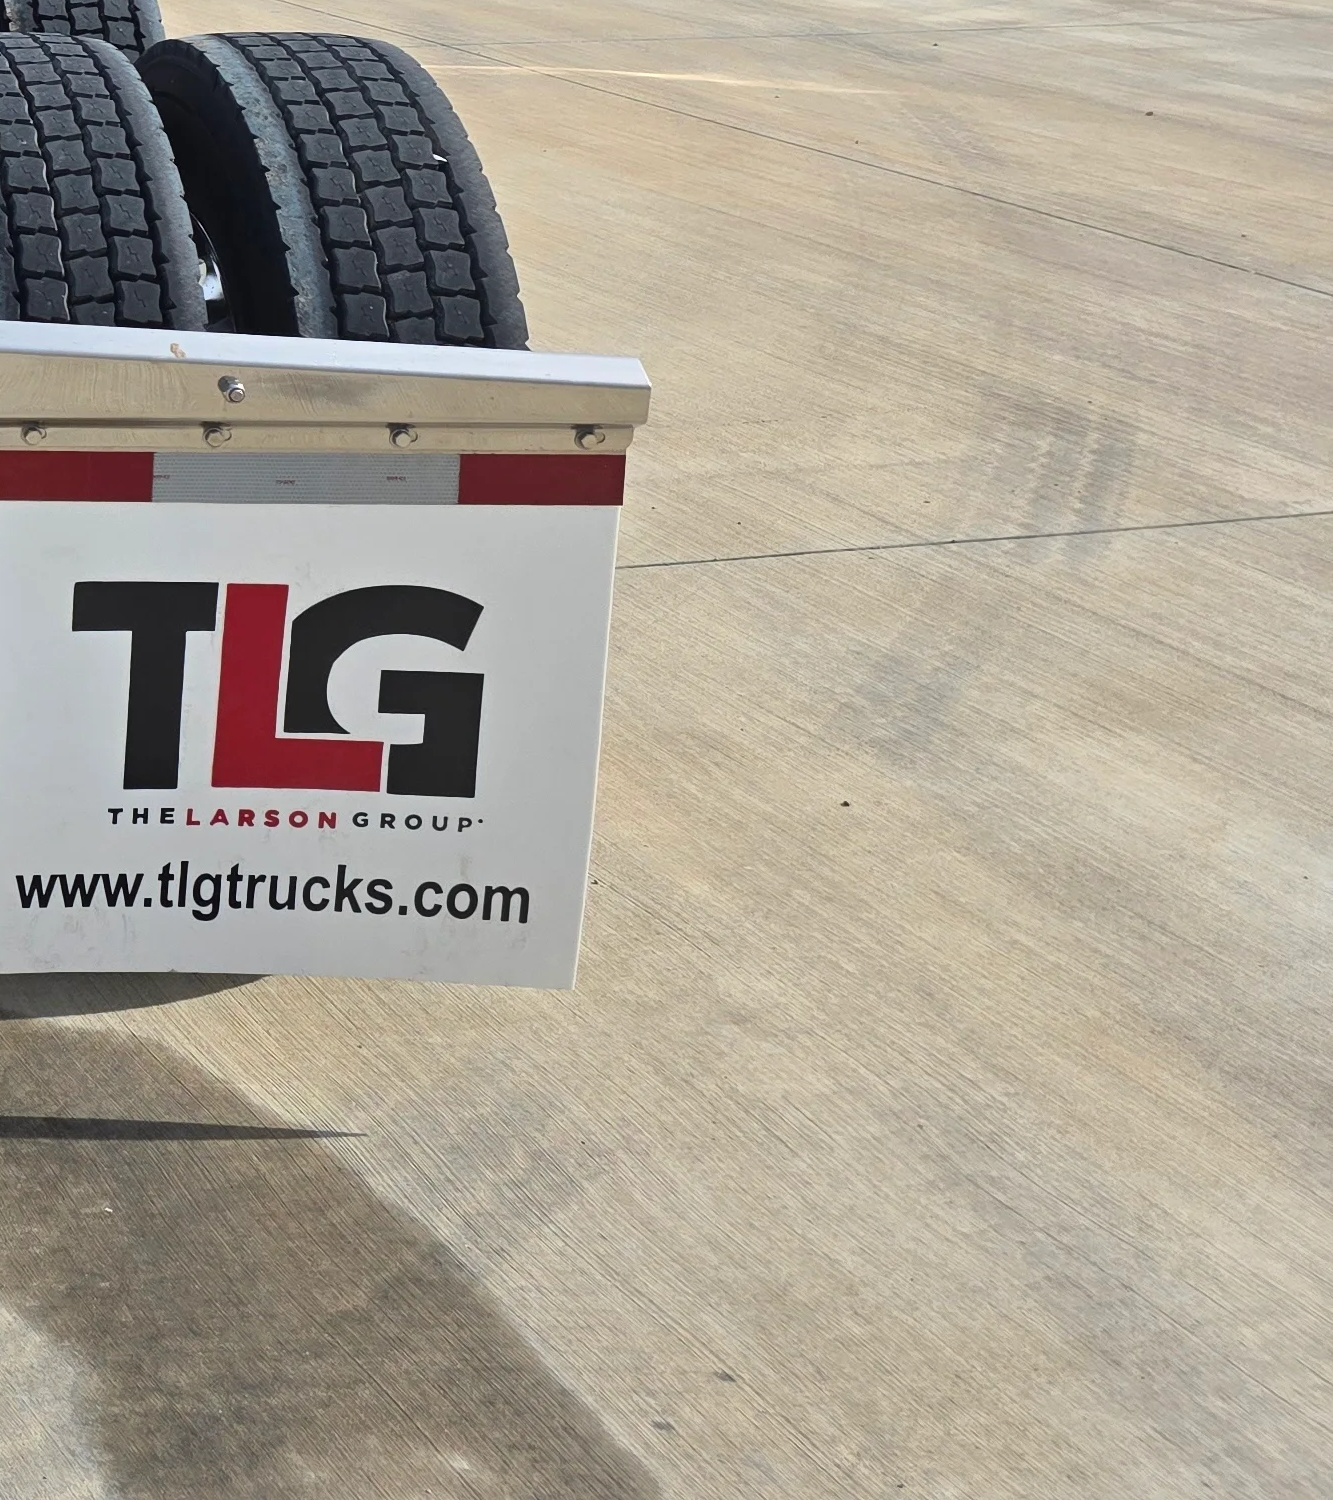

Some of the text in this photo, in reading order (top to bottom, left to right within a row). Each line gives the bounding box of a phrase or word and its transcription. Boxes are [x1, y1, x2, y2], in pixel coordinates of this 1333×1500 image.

[72, 581, 485, 798] TLG
[352, 811, 473, 832] GROUP
[16, 861, 530, 924] www.tlgtrucks.com
